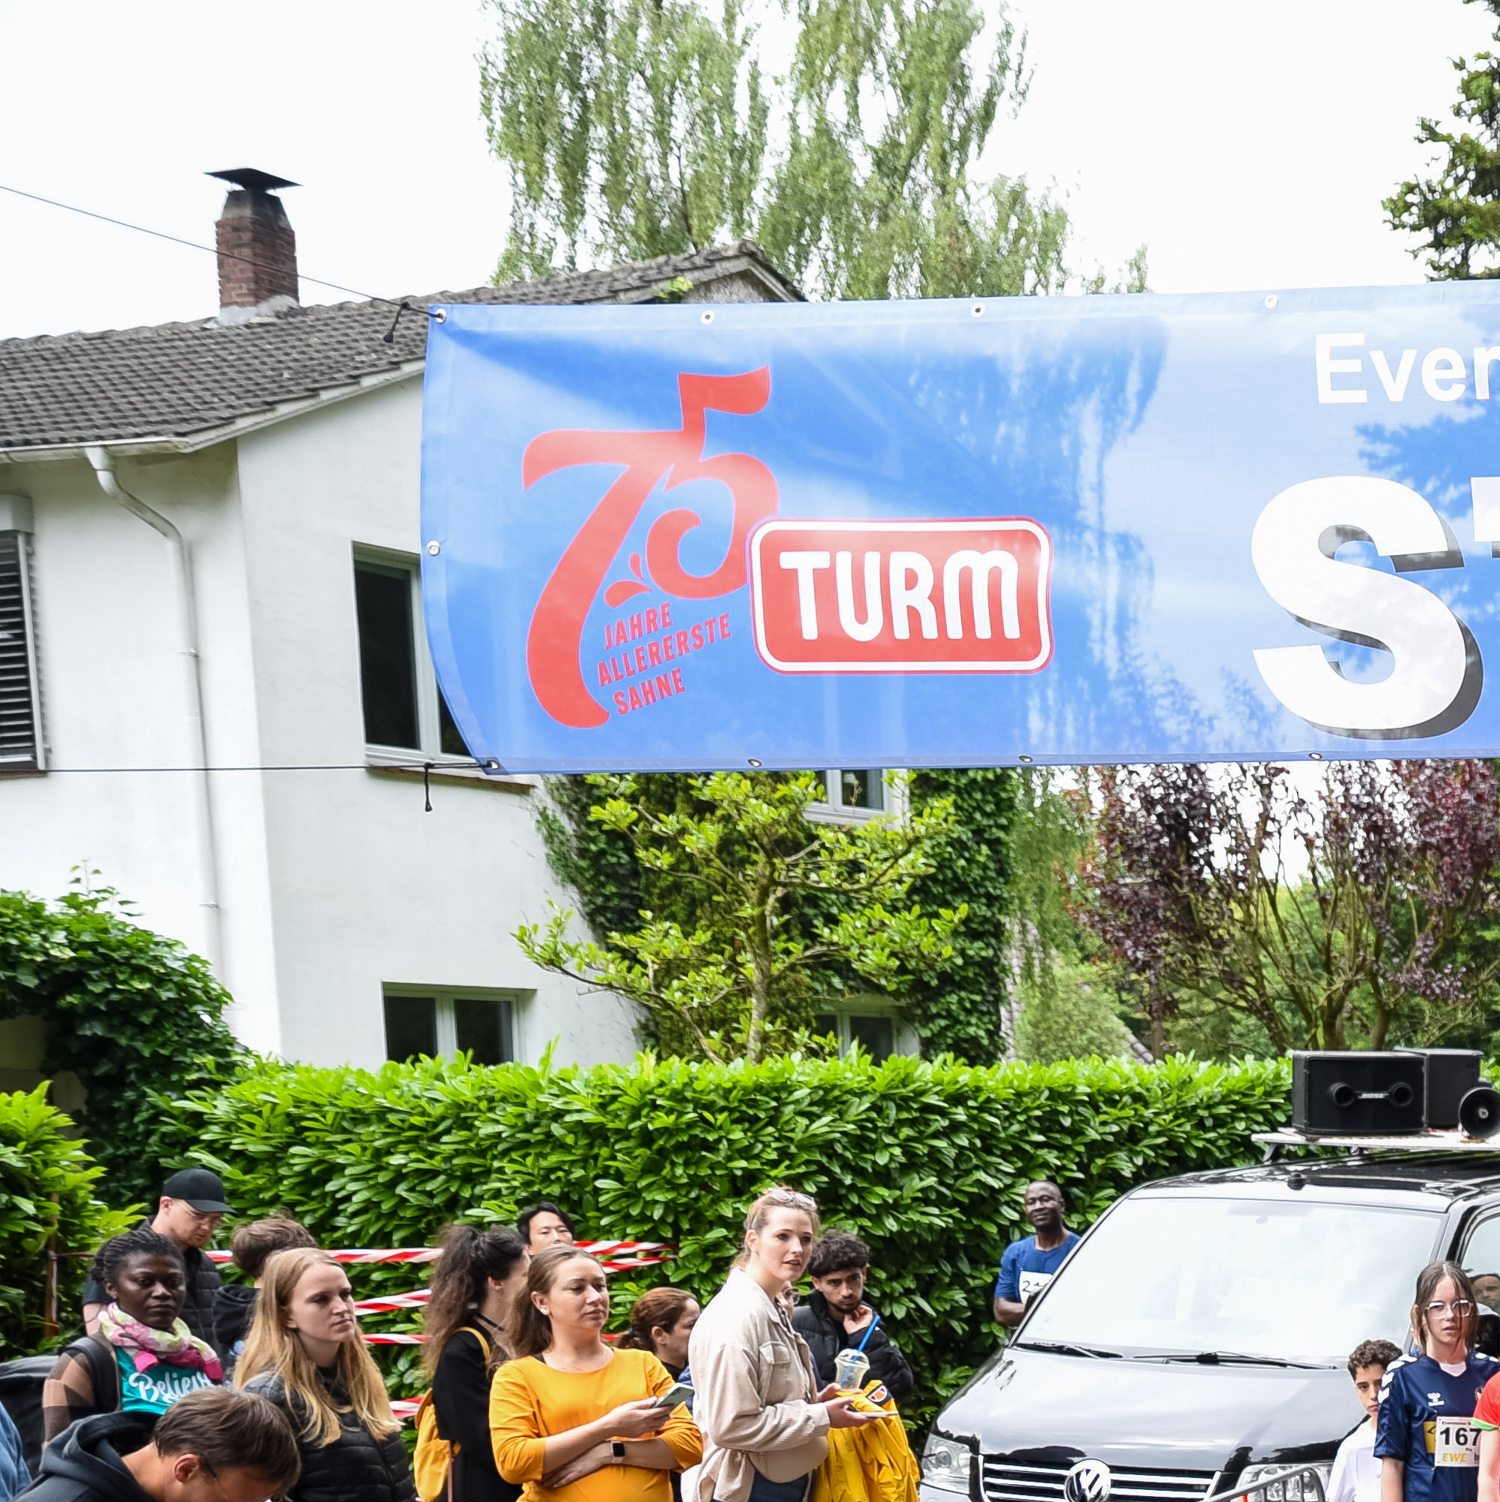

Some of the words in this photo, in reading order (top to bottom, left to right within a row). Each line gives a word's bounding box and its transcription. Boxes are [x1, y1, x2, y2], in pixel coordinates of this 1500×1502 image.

[522, 365, 779, 729] 75
[779, 549, 1021, 643] TURM
[597, 612, 732, 688] ALLERERSTE
[604, 601, 673, 651] JAHRE
[613, 667, 686, 716] SAHNE
[1440, 1427, 1482, 1446] 167
[1442, 1452, 1467, 1463] EWE
